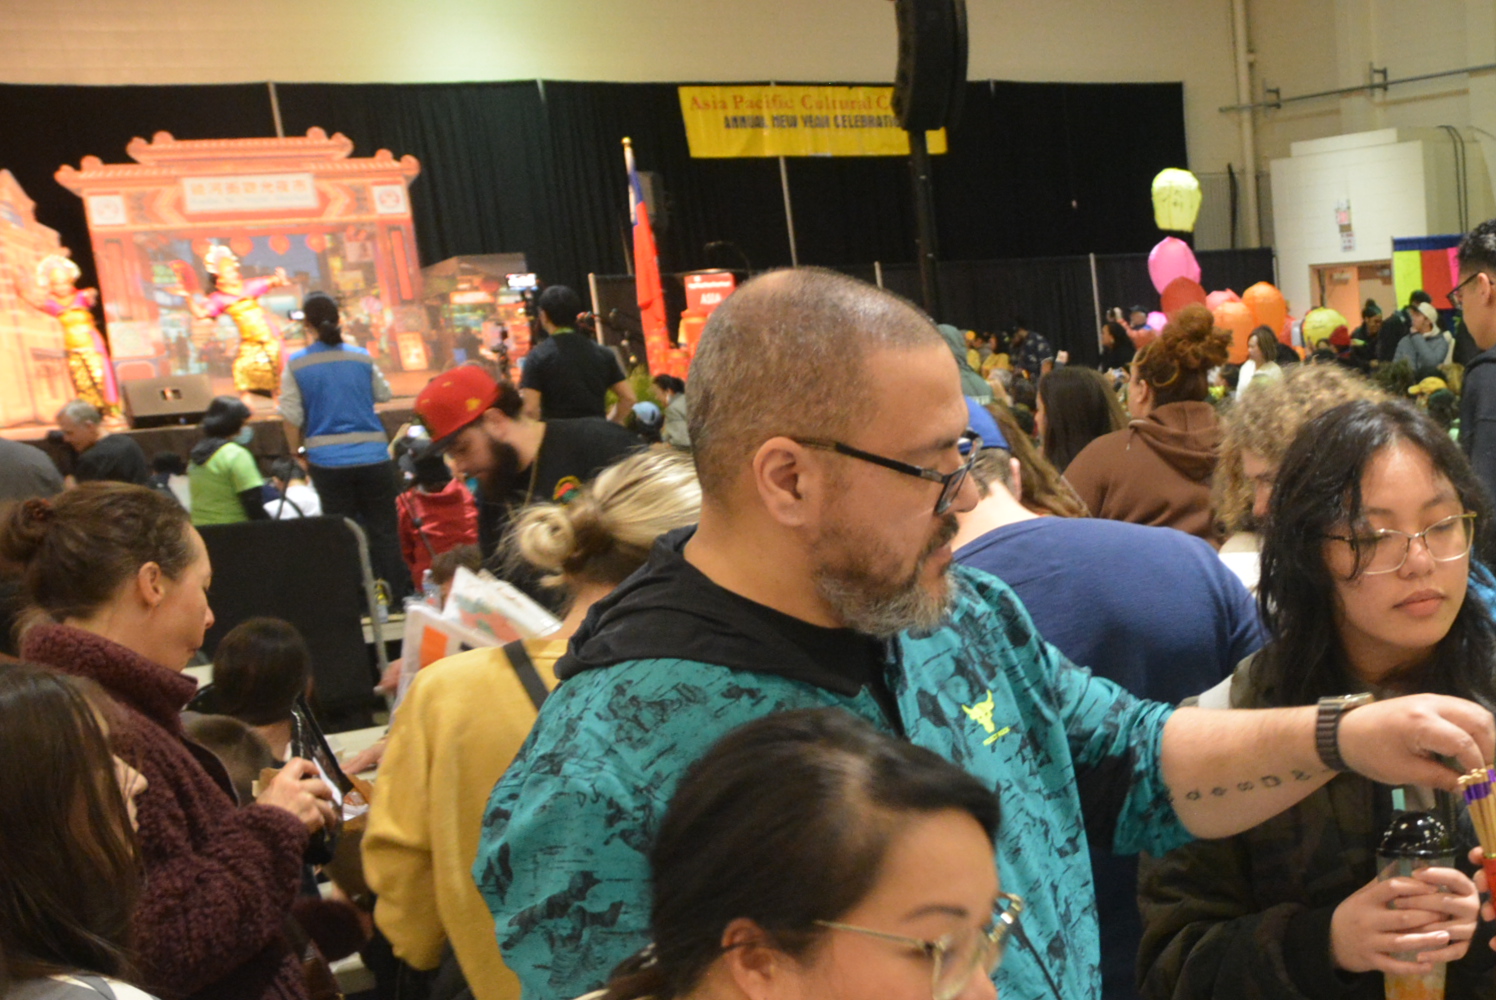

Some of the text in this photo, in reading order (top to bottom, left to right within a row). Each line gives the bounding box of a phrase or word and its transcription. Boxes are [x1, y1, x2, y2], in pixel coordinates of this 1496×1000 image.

[690, 95, 728, 111] Asia
[733, 94, 794, 110] Pacific
[801, 94, 872, 110] Cultural
[724, 114, 901, 129] ANNUAL NEW YEAR CELEBRATIO
